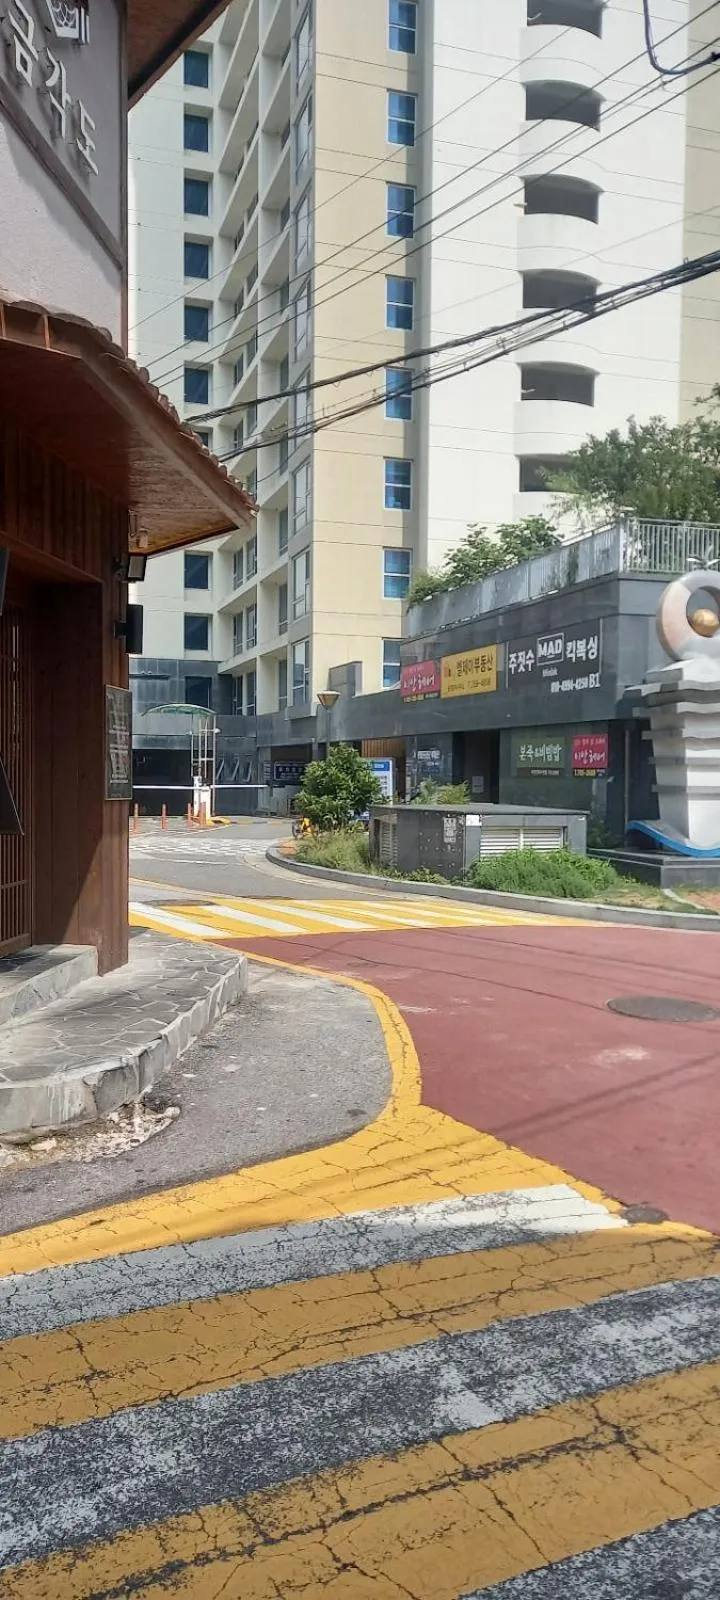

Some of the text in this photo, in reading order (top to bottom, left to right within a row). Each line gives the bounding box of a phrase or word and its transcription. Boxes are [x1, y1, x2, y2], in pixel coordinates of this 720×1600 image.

[508, 635, 599, 675] 주짓수 MAD 킥복싱
[589, 672, 601, 688] B1
